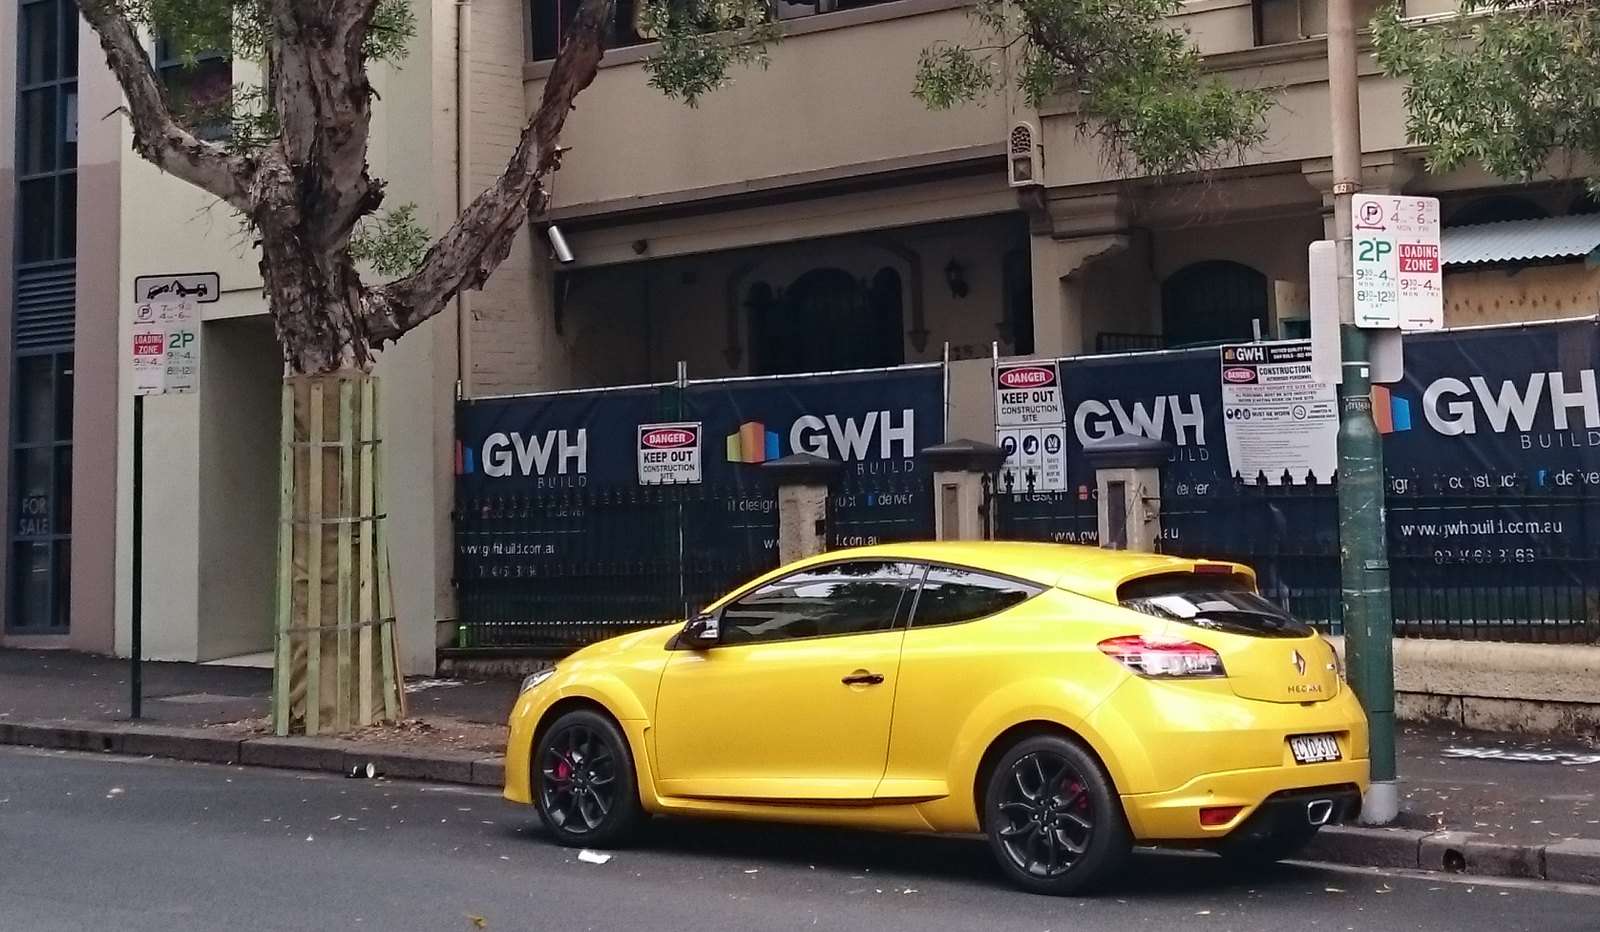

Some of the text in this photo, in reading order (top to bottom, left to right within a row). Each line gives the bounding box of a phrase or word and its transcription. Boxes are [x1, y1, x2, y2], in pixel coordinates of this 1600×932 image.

[1358, 240, 1392, 262] 2P
[1399, 246, 1438, 258] LOADING
[1405, 260, 1434, 272] ZONE
[169, 332, 194, 349] 2P
[138, 345, 158, 354] ZONE
[1236, 347, 1264, 361] GWH
[1007, 372, 1046, 384] DANGER
[1001, 390, 1054, 405] KEEP OUT
[1422, 369, 1600, 436] GWH
[1001, 404, 1058, 415] CONSTRUCTION
[1022, 413, 1038, 422] SITE
[1074, 394, 1205, 449] GWH
[649, 434, 686, 444] DANGER
[789, 409, 914, 461] GWH
[1520, 431, 1600, 449] BUILD
[481, 428, 588, 478] GWH
[644, 451, 693, 463] KEEP OUT
[643, 464, 695, 473] CONSTRUCTION
[857, 459, 914, 475] BUILD
[537, 475, 588, 489] BUILD
[22, 497, 47, 514] FOR
[19, 518, 48, 535] SALE
